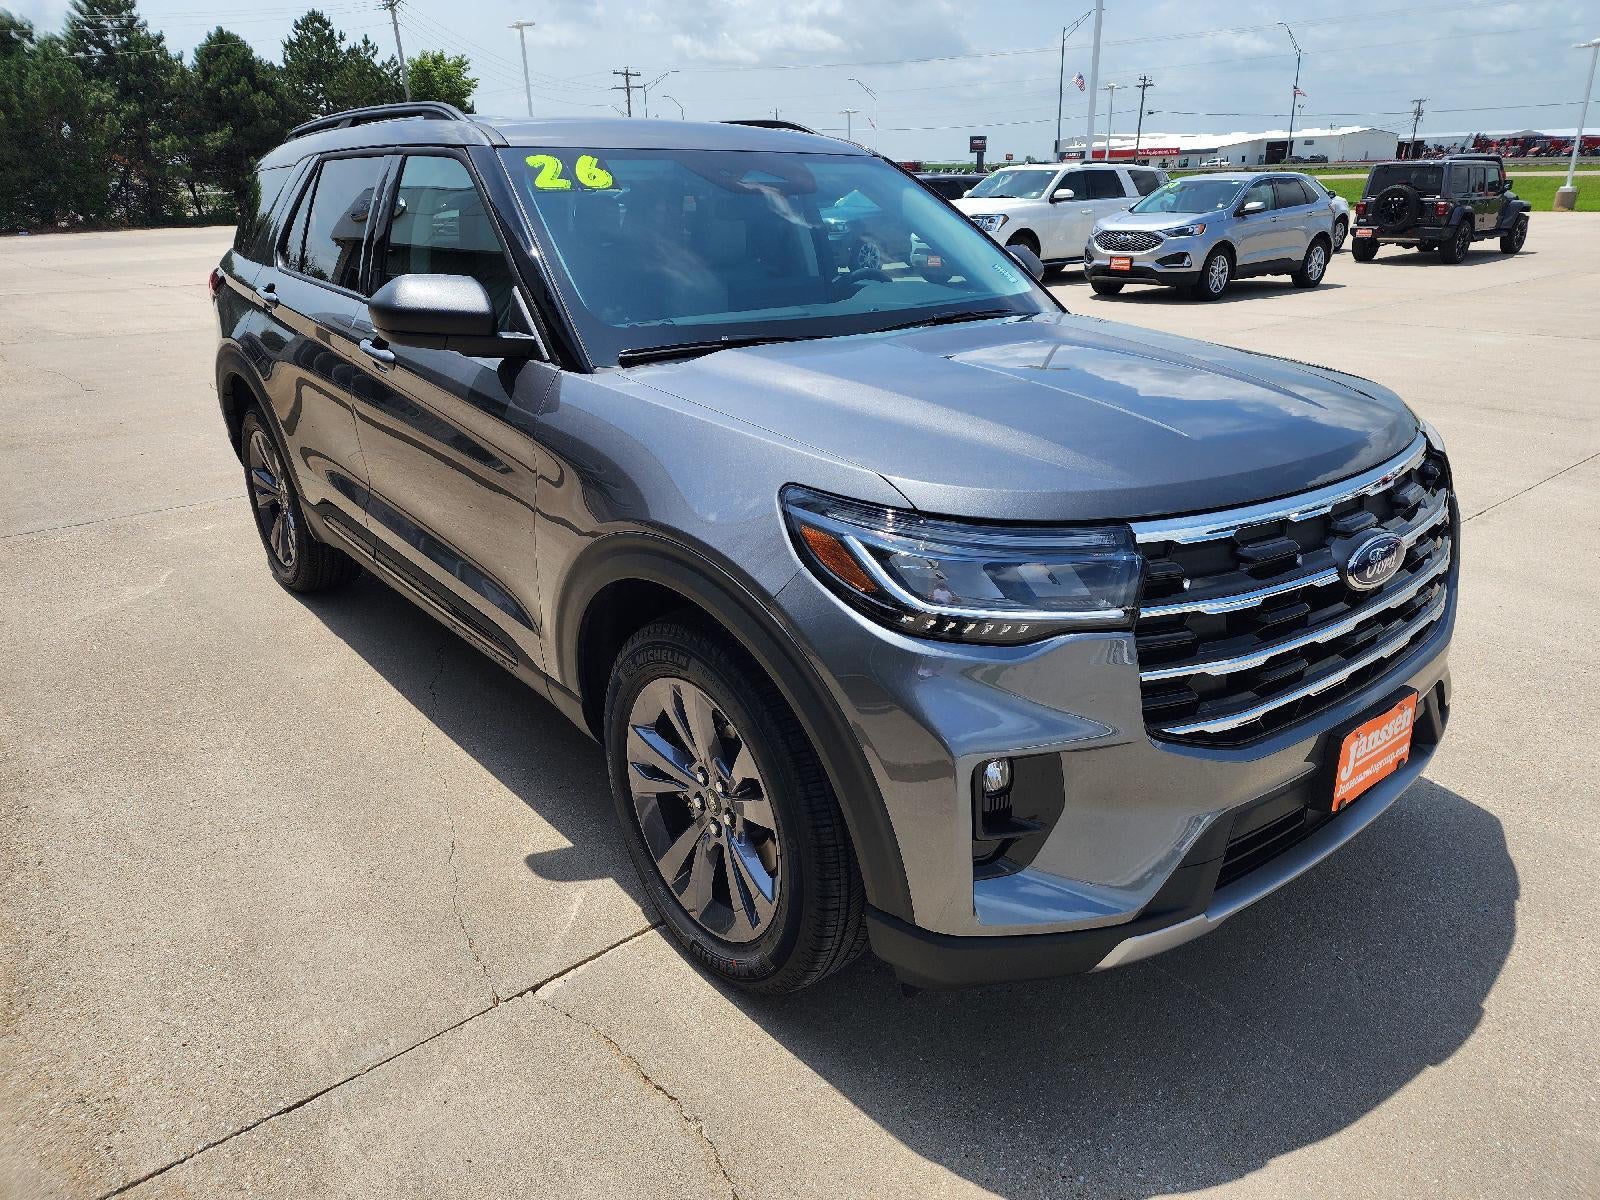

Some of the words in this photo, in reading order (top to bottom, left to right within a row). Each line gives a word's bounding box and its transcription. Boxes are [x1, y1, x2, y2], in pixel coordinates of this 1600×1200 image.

[525, 154, 613, 189] 26
[634, 649, 689, 667] MICHELIN
[1341, 707, 1413, 782] Janssen
